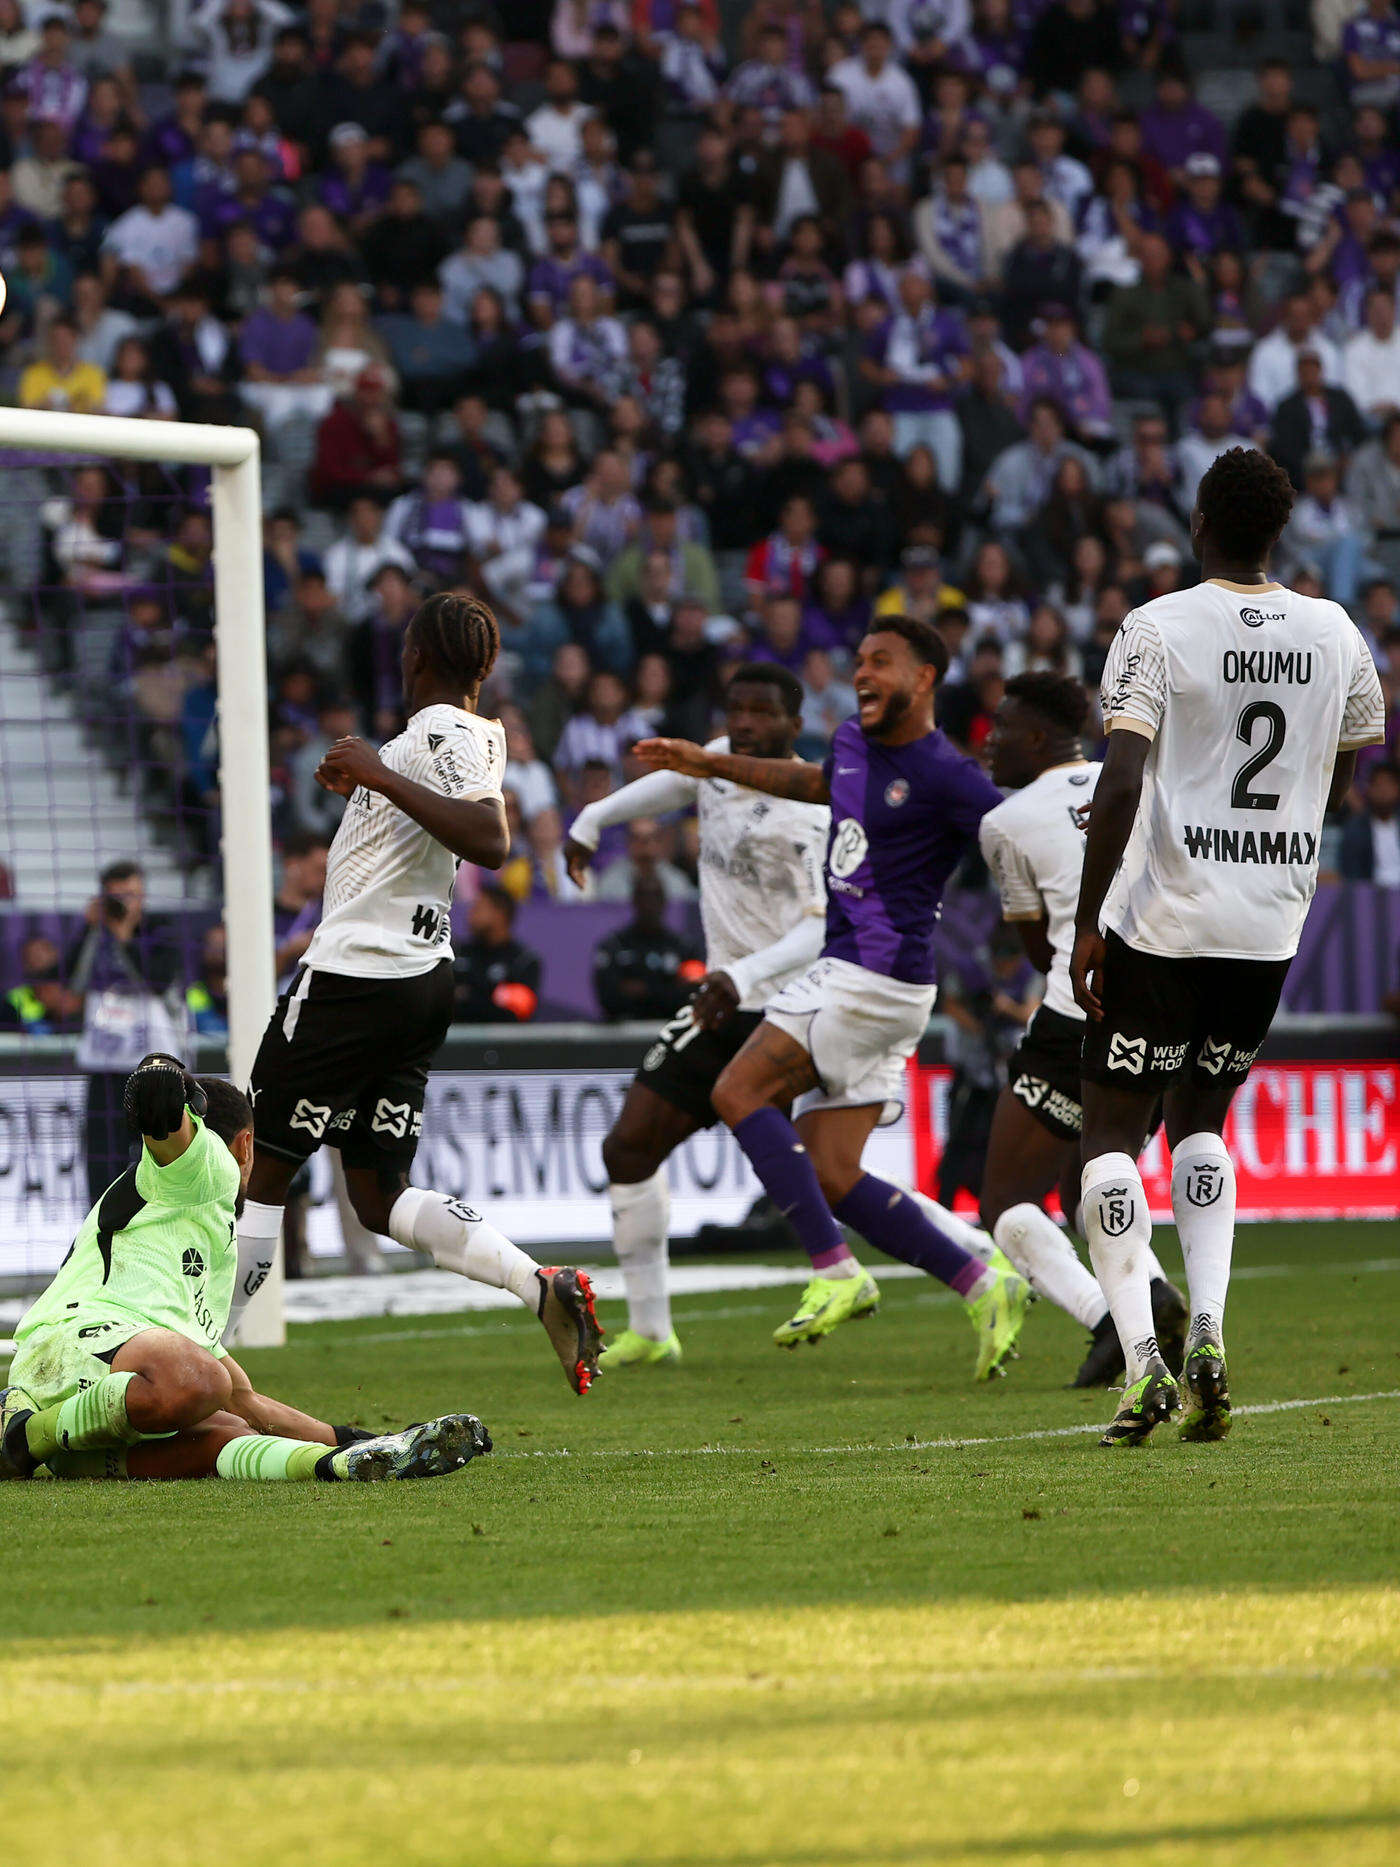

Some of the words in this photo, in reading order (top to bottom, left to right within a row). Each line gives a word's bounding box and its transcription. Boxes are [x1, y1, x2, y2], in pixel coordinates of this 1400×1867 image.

[1222, 650, 1312, 685] OKUMU
[1230, 700, 1287, 811] 2
[1184, 825, 1318, 866] WINAMAX
